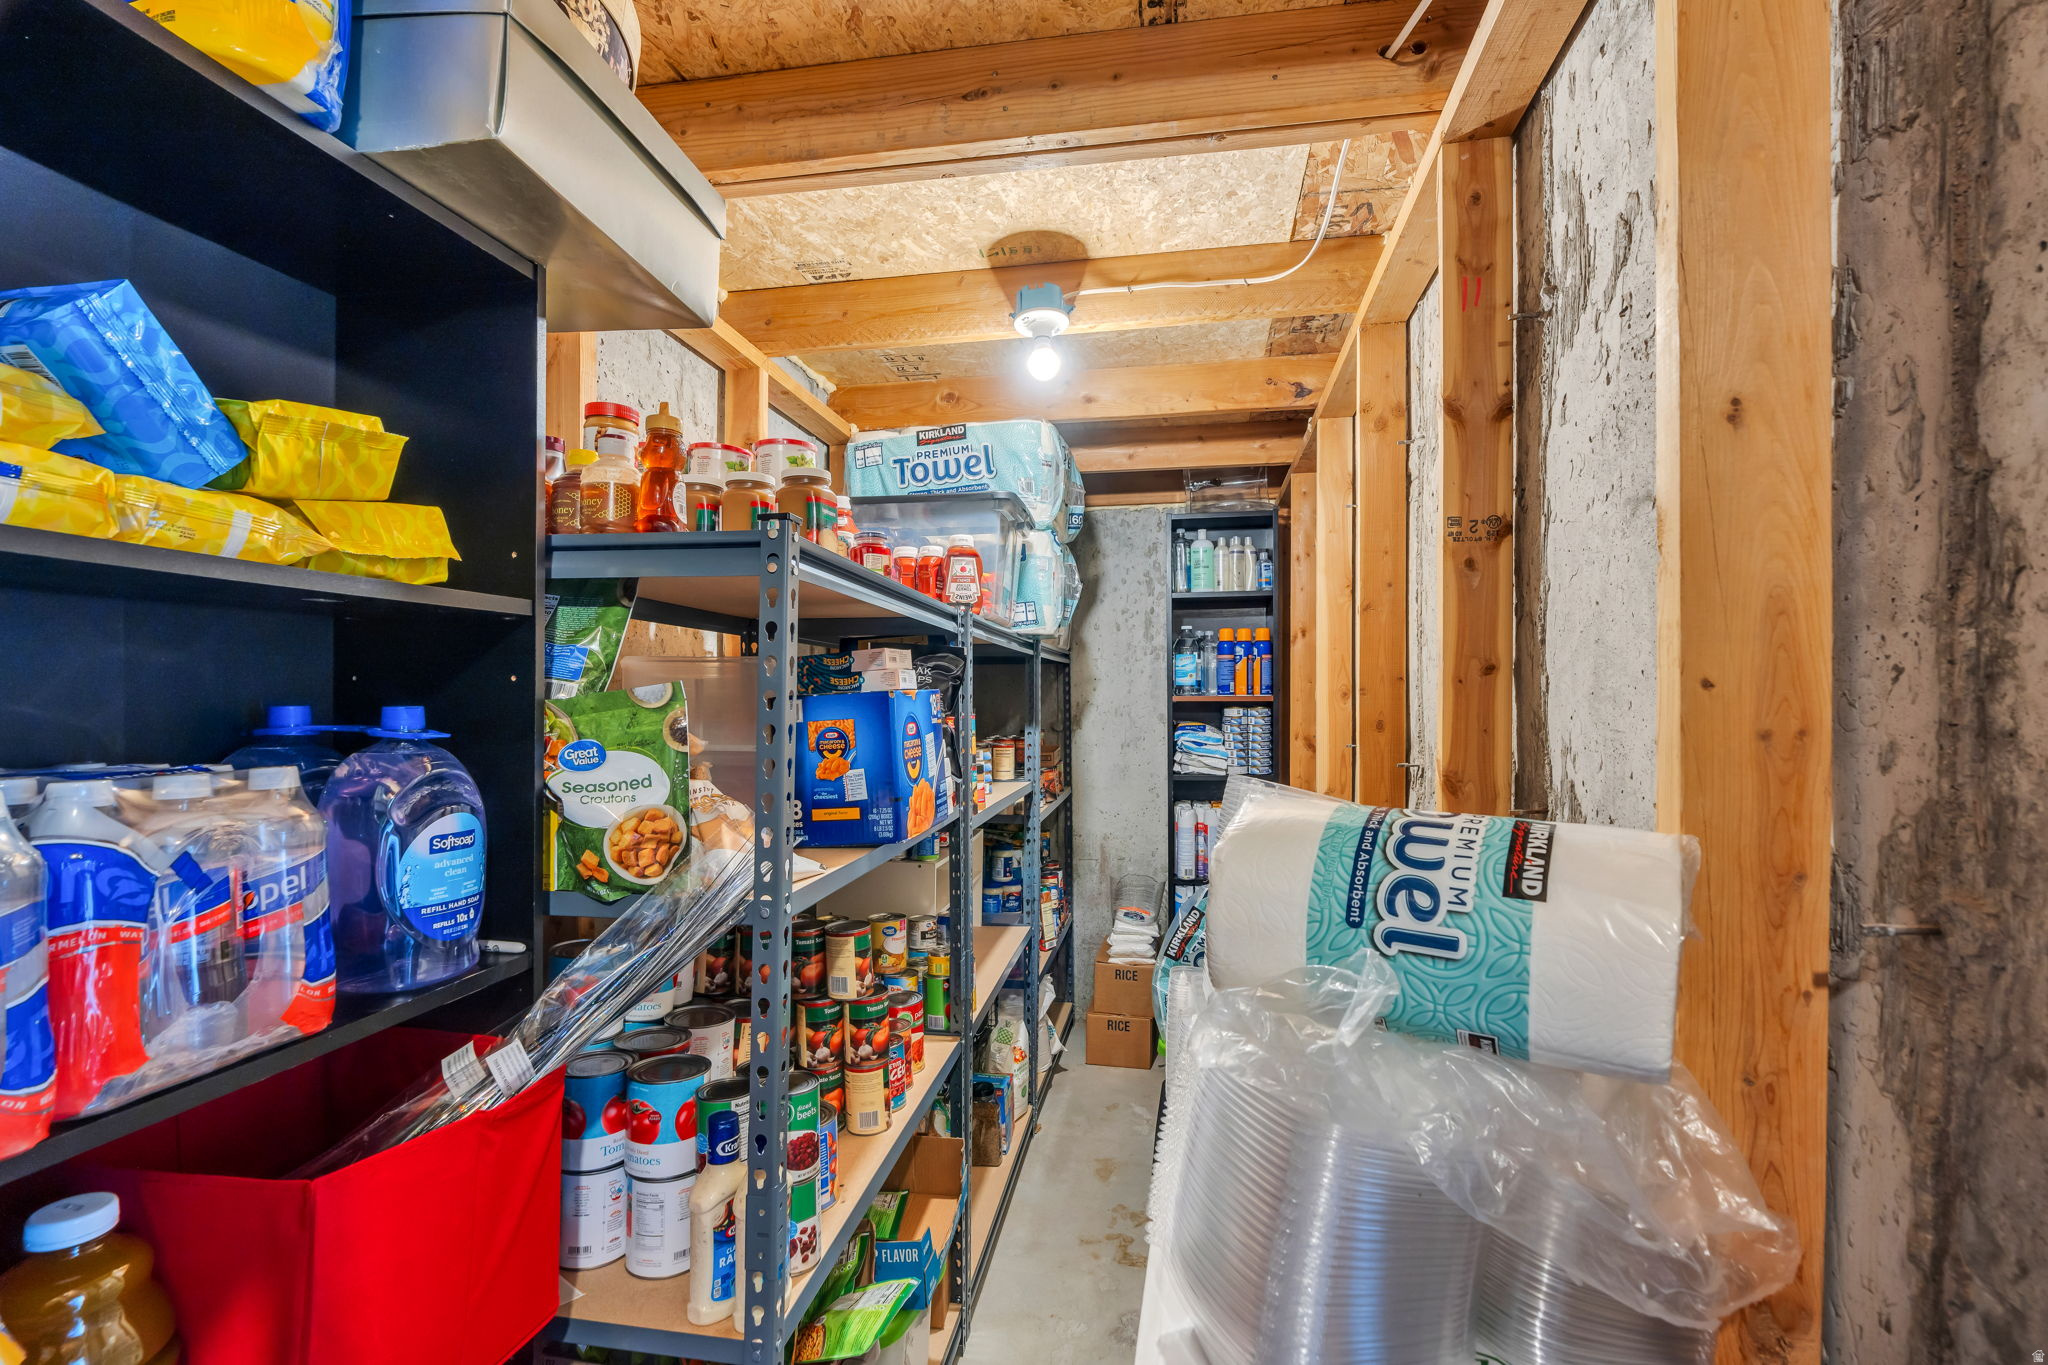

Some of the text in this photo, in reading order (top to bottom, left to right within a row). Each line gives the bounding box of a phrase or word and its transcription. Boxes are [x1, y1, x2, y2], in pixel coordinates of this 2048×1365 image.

[919, 425, 965, 440] KIRKLAND
[916, 444, 970, 460] PREMIUM
[891, 443, 995, 486] Towel
[957, 484, 989, 493] Absorbent
[954, 593, 973, 601] HEINZ
[823, 655, 850, 666] CHEESE
[915, 666, 932, 676] AK
[830, 674, 860, 686] CHEESE
[564, 746, 599, 760] Great
[572, 756, 600, 767] Value
[561, 773, 653, 794] Seasoned
[580, 794, 637, 805] Croutons
[793, 799, 803, 820] 8
[432, 833, 475, 850] Softsoap
[1364, 830, 1375, 851] and
[434, 854, 474, 869] advanced
[444, 866, 467, 877] clean
[1349, 852, 1370, 924] Absorbent
[421, 895, 480, 915] REFILL HAND SOAP
[433, 912, 468, 929] REFILLS 10x
[1165, 907, 1201, 958] KIRKLAND
[1115, 969, 1139, 982] RICE
[866, 1003, 884, 1013] Tomato
[1107, 1019, 1131, 1033] RICE
[829, 1072, 841, 1081] Sauce
[890, 1065, 905, 1081] CED
[796, 1106, 817, 1121] beets
[797, 1101, 812, 1112] diced
[881, 1248, 919, 1263] FLAVOR
